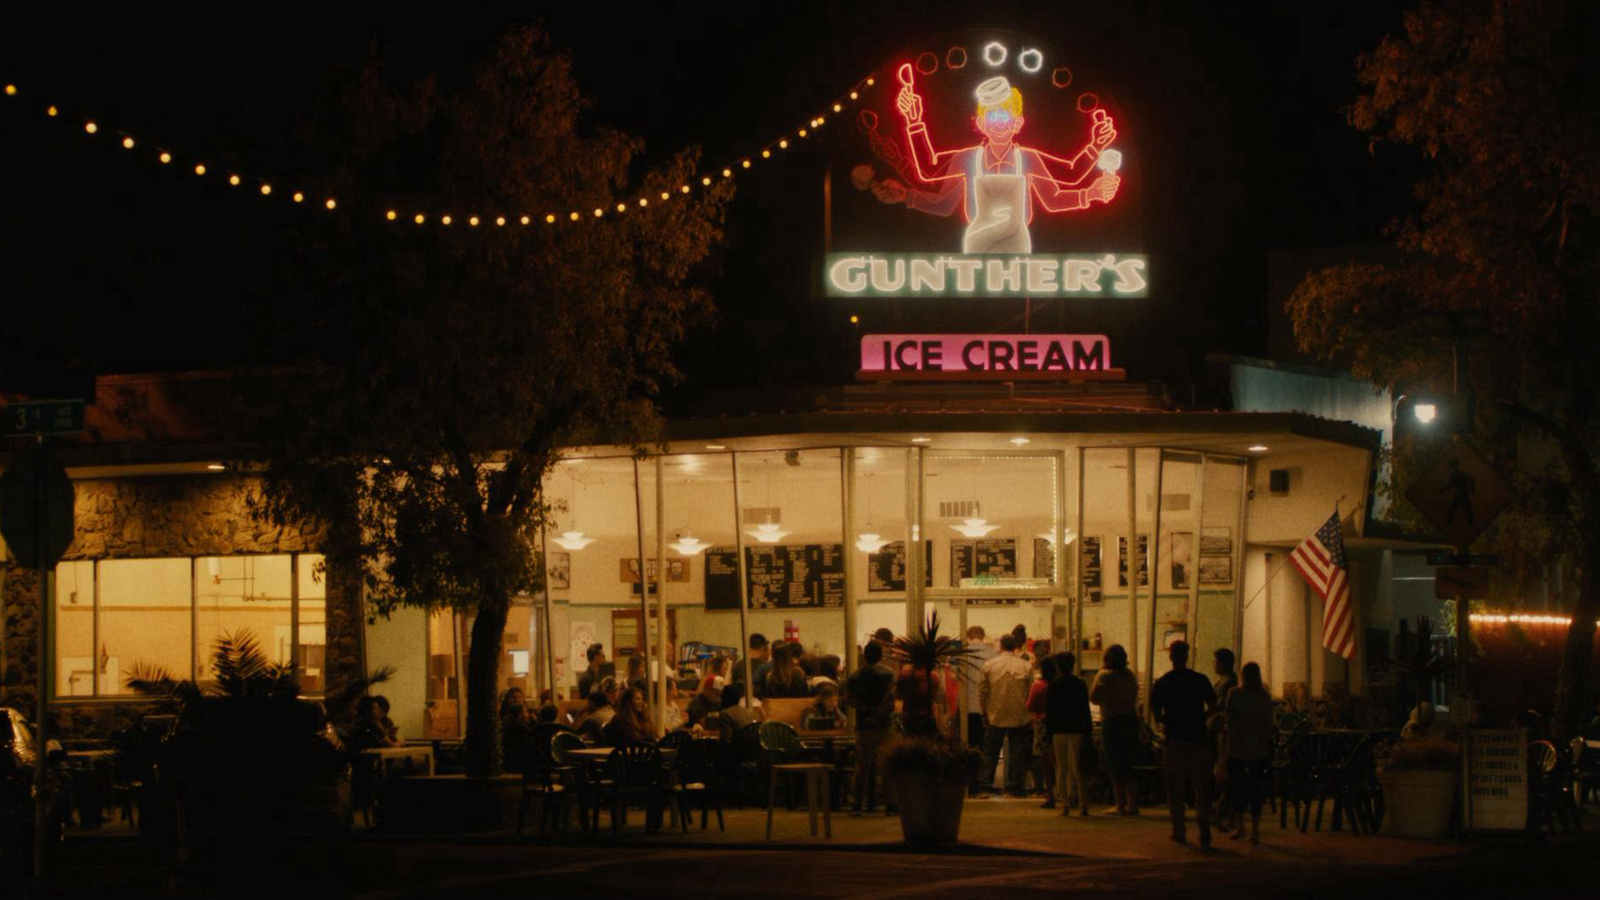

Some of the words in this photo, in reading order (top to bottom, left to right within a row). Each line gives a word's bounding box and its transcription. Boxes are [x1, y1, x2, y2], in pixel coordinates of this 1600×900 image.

[829, 255, 1146, 293] GUNTHER'S
[883, 340, 942, 372] ICE
[962, 340, 1104, 372] CREAM
